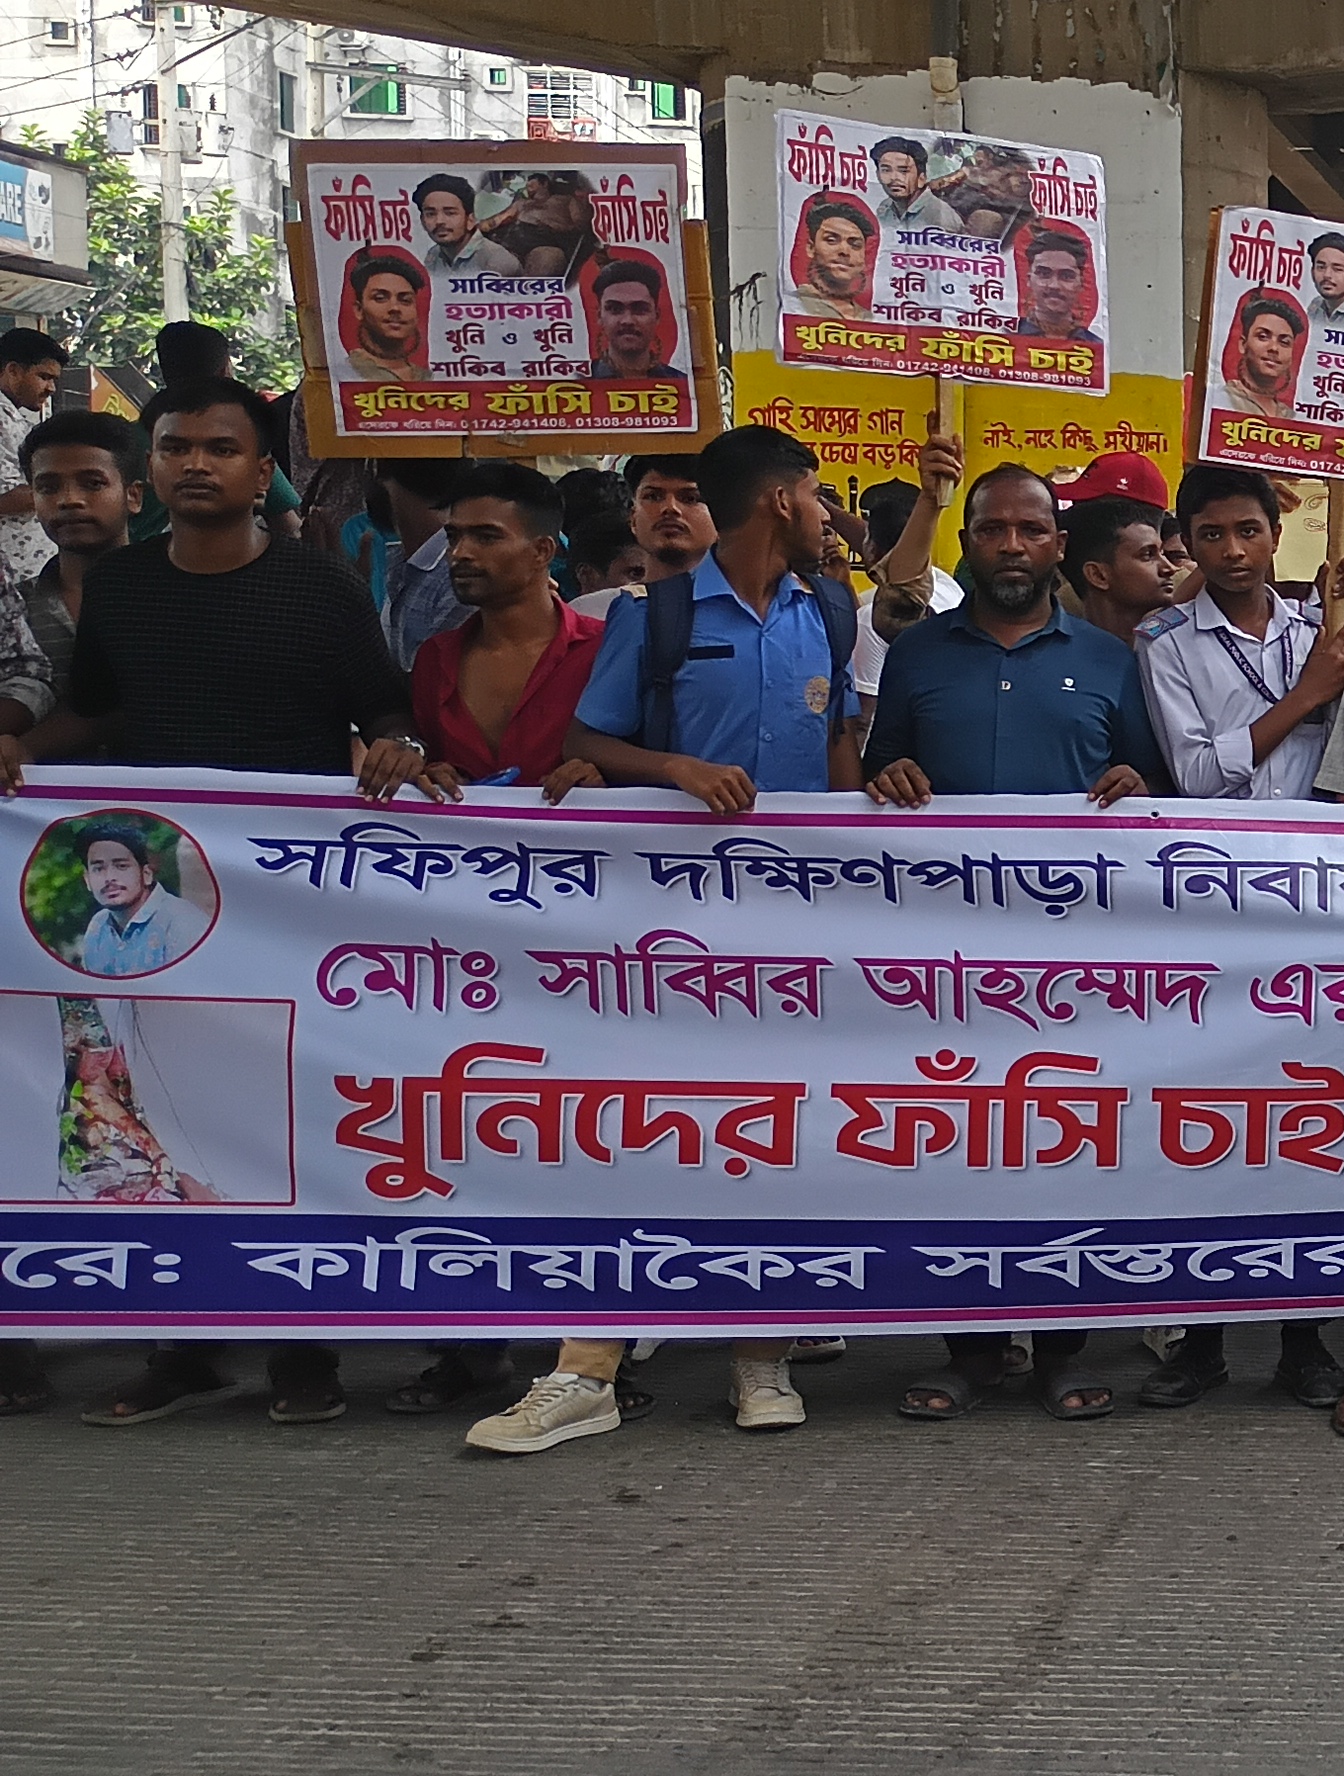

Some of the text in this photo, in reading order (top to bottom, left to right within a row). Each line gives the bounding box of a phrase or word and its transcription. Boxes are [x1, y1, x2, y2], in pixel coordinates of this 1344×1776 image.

[787, 123, 867, 193] ফাঁসি চাই
[1028, 156, 1098, 221] ফাঁসি চাই
[321, 174, 413, 243] ফাঁসি চাই
[590, 173, 670, 244] ফাঁসি চাই
[897, 227, 999, 255] সাব্বিরের
[1229, 217, 1305, 290] ফাঁসি চাই
[891, 252, 1006, 279] হত্যাকারী
[449, 273, 564, 294] সাব্বিরের
[891, 272, 1003, 306] খুনি ও খুনি
[445, 297, 572, 321] হত্যাকারী
[873, 302, 1019, 331] শাকিব রাকিব
[447, 323, 573, 352] খুনি ও খুনি
[796, 321, 1094, 376] খুনিদের ফাঁসি চাই
[431, 355, 591, 377] শাকিব রাকিব
[353, 383, 679, 417] খুনিদের ফাঁসি চাই
[868, 408, 905, 435] গান
[1220, 418, 1322, 451] খুনিদের
[863, 443, 896, 469] বড়
[246, 820, 610, 910] সফিপুর
[635, 836, 1124, 919] দক্ষিণপাড়া
[315, 939, 500, 1014] মোঃ
[524, 929, 832, 1018] সাব্বির
[853, 948, 1222, 1031] আহম্মেদ
[332, 1041, 805, 1203] খুনিদের
[830, 1049, 1129, 1173] ফাঁসি
[231, 1228, 887, 1294] কালিয়াকৈর
